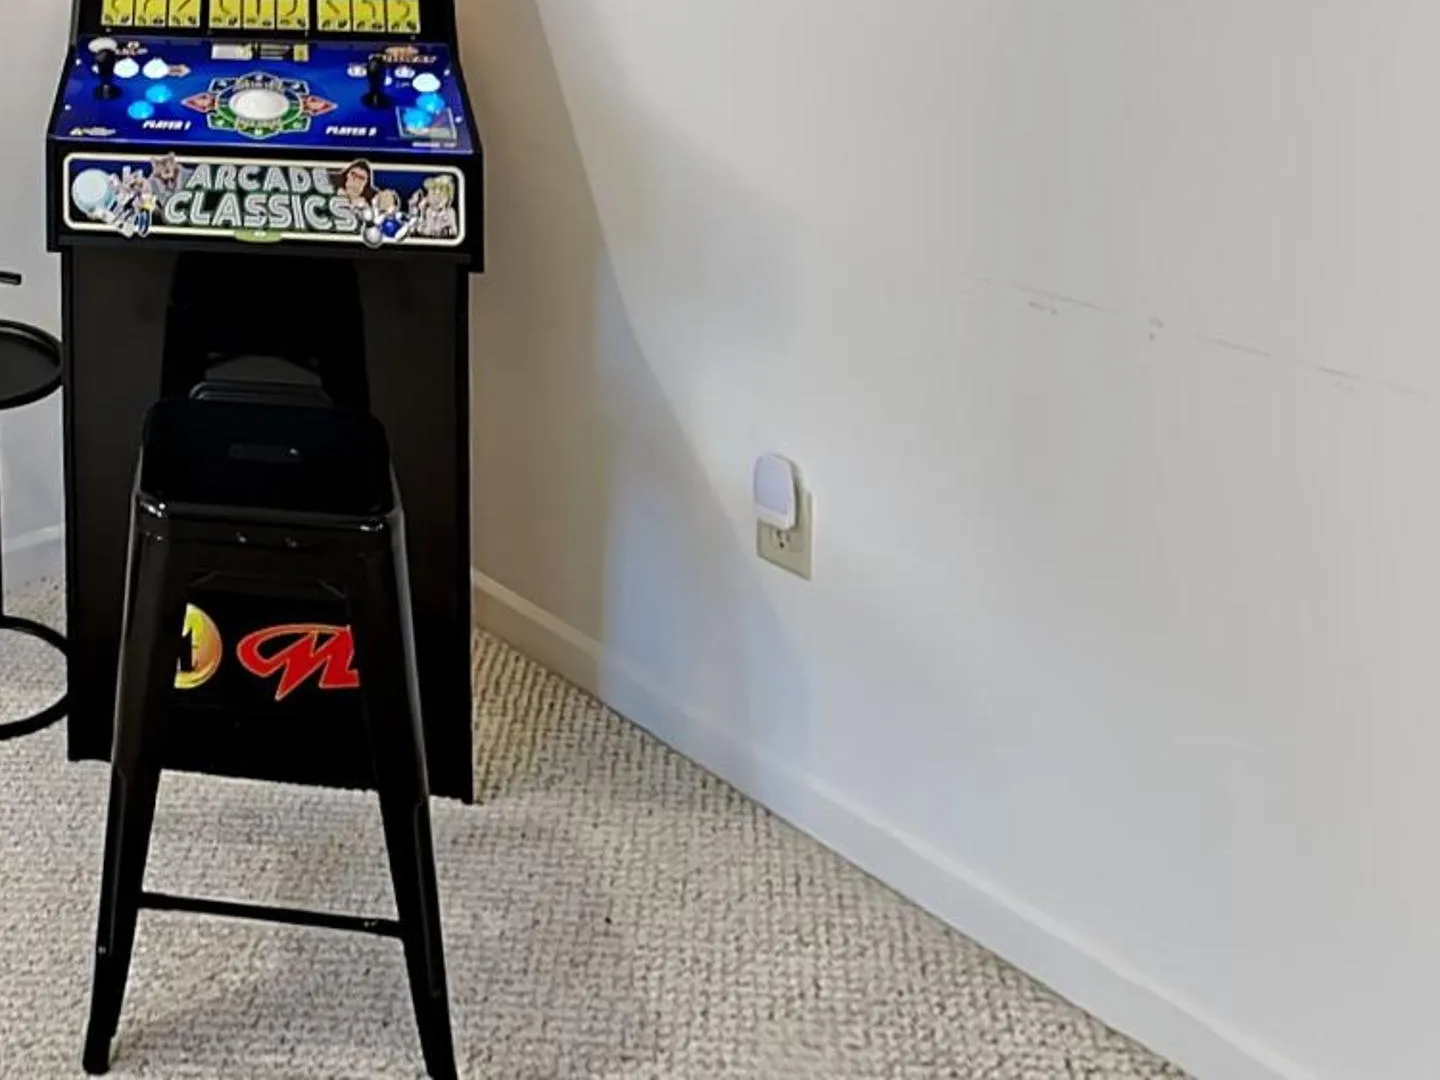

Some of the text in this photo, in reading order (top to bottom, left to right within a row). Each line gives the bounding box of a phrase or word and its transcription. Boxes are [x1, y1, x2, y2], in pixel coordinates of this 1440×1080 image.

[142, 120, 183, 130] PLAYER
[325, 126, 365, 136] PLAYER
[186, 164, 335, 194] ARCADE
[164, 191, 358, 231] CLASSICS
